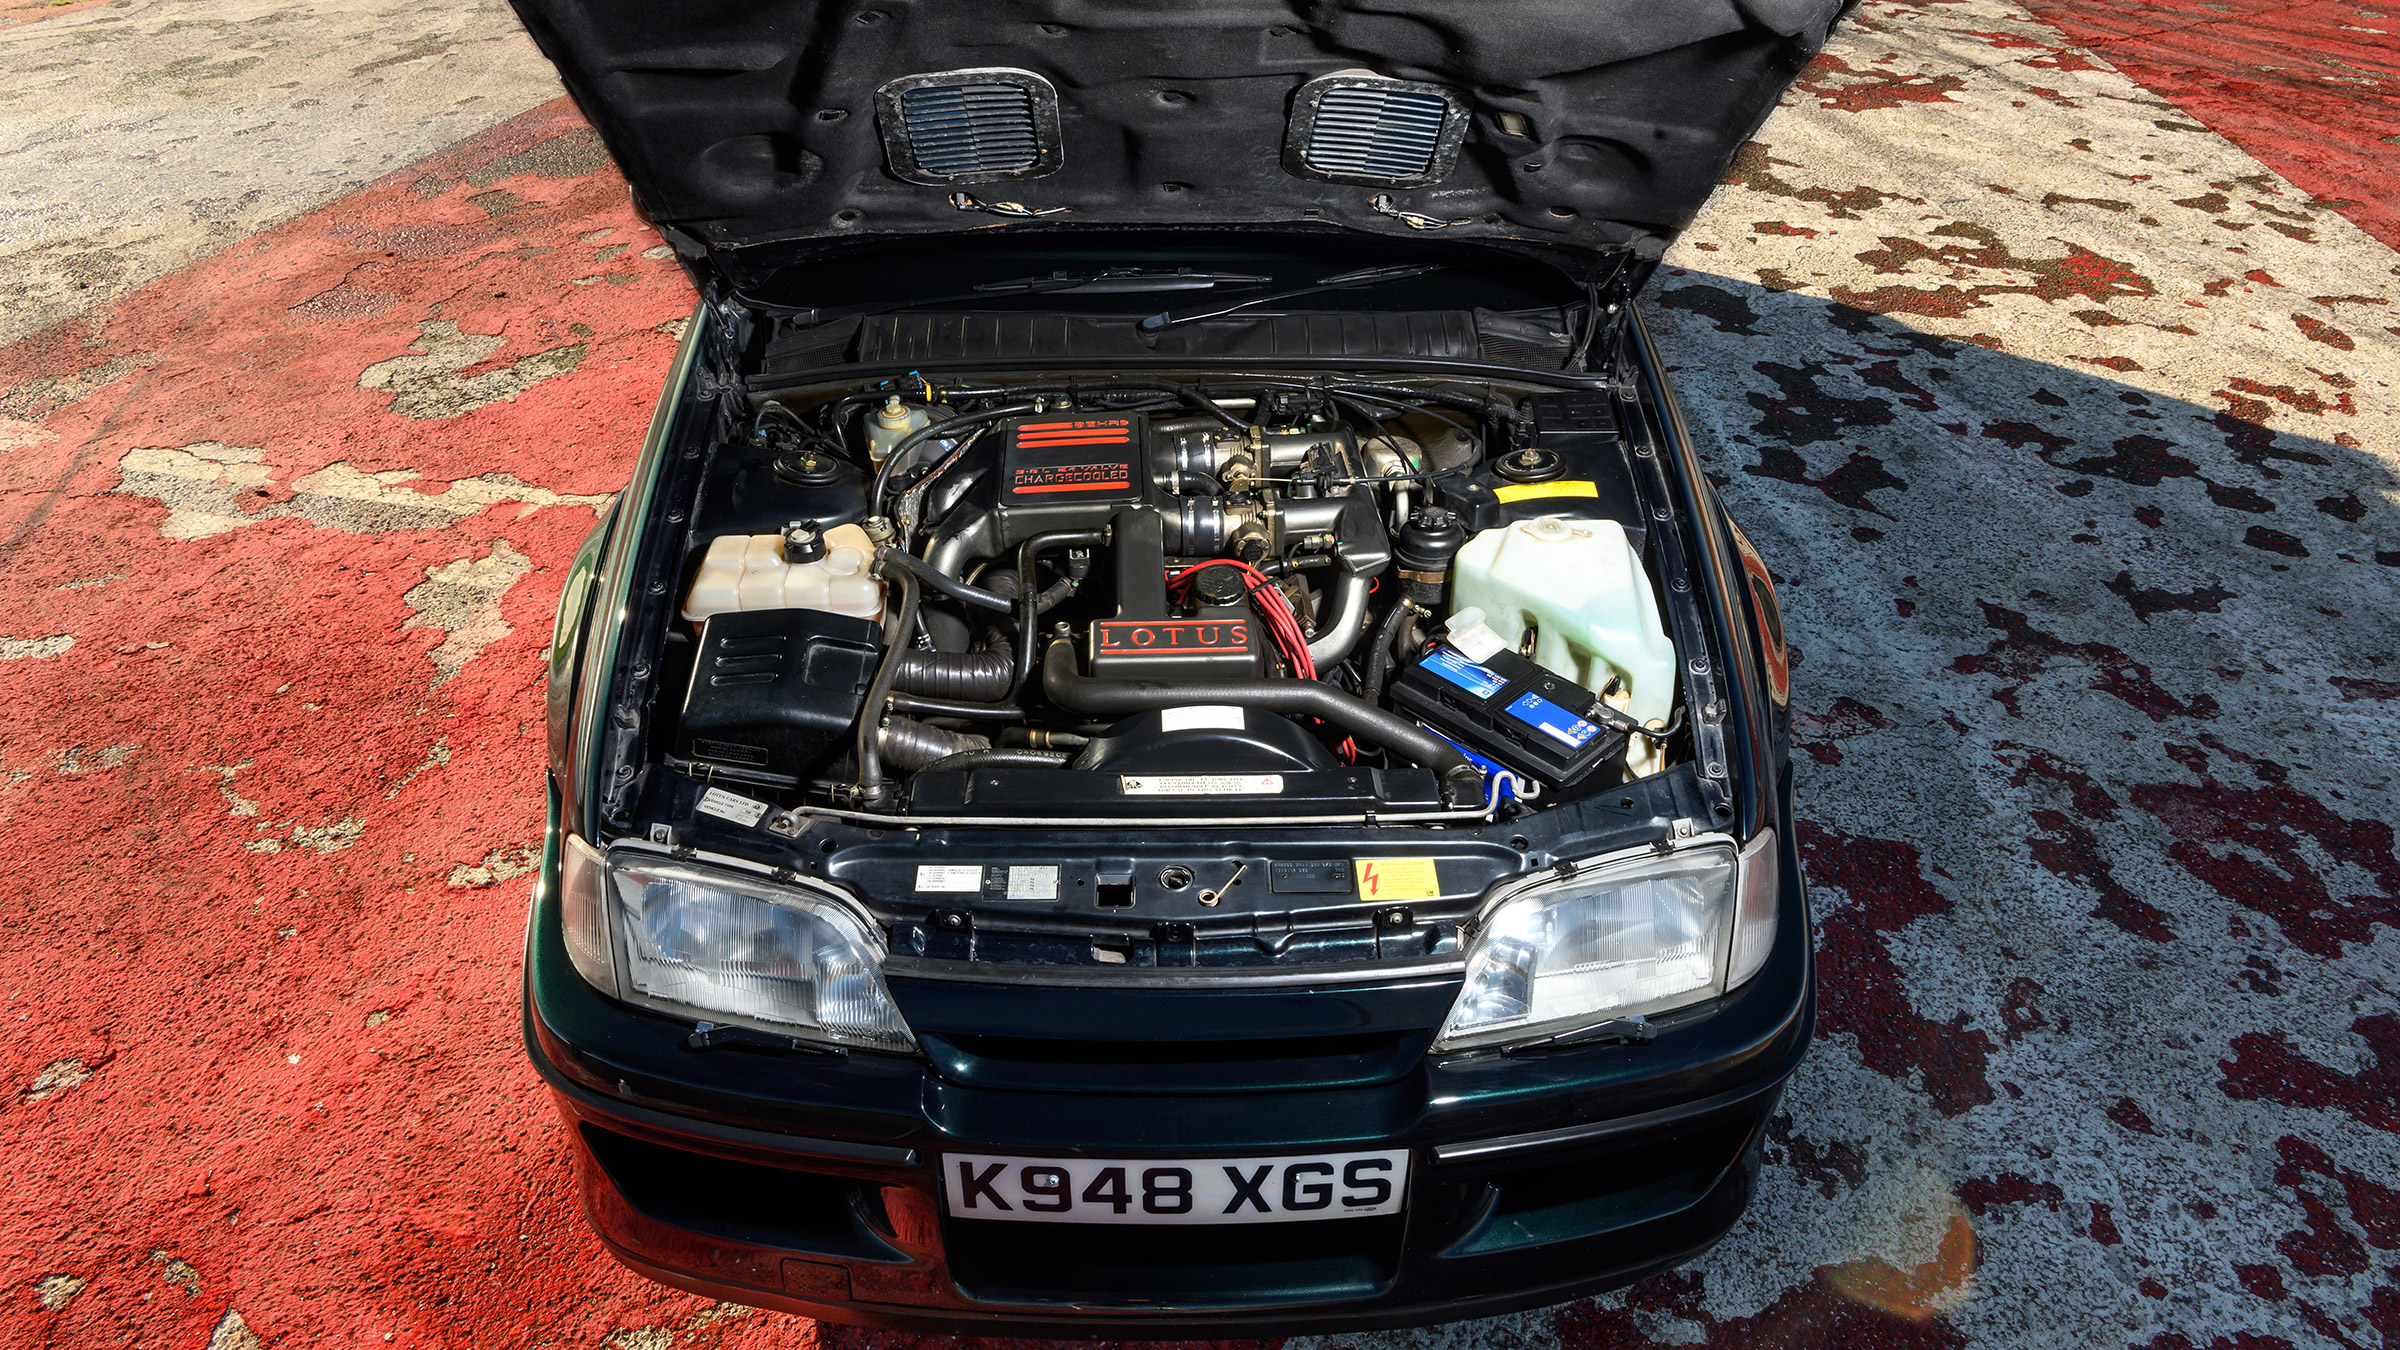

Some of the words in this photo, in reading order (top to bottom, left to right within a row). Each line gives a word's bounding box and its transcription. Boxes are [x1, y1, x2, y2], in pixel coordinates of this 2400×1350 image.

[1014, 469, 1129, 485] CHARGECOOLED
[1099, 625, 1249, 647] LOTUS
[959, 1161, 1193, 1214] K948
[1222, 1158, 1393, 1214] XGS
